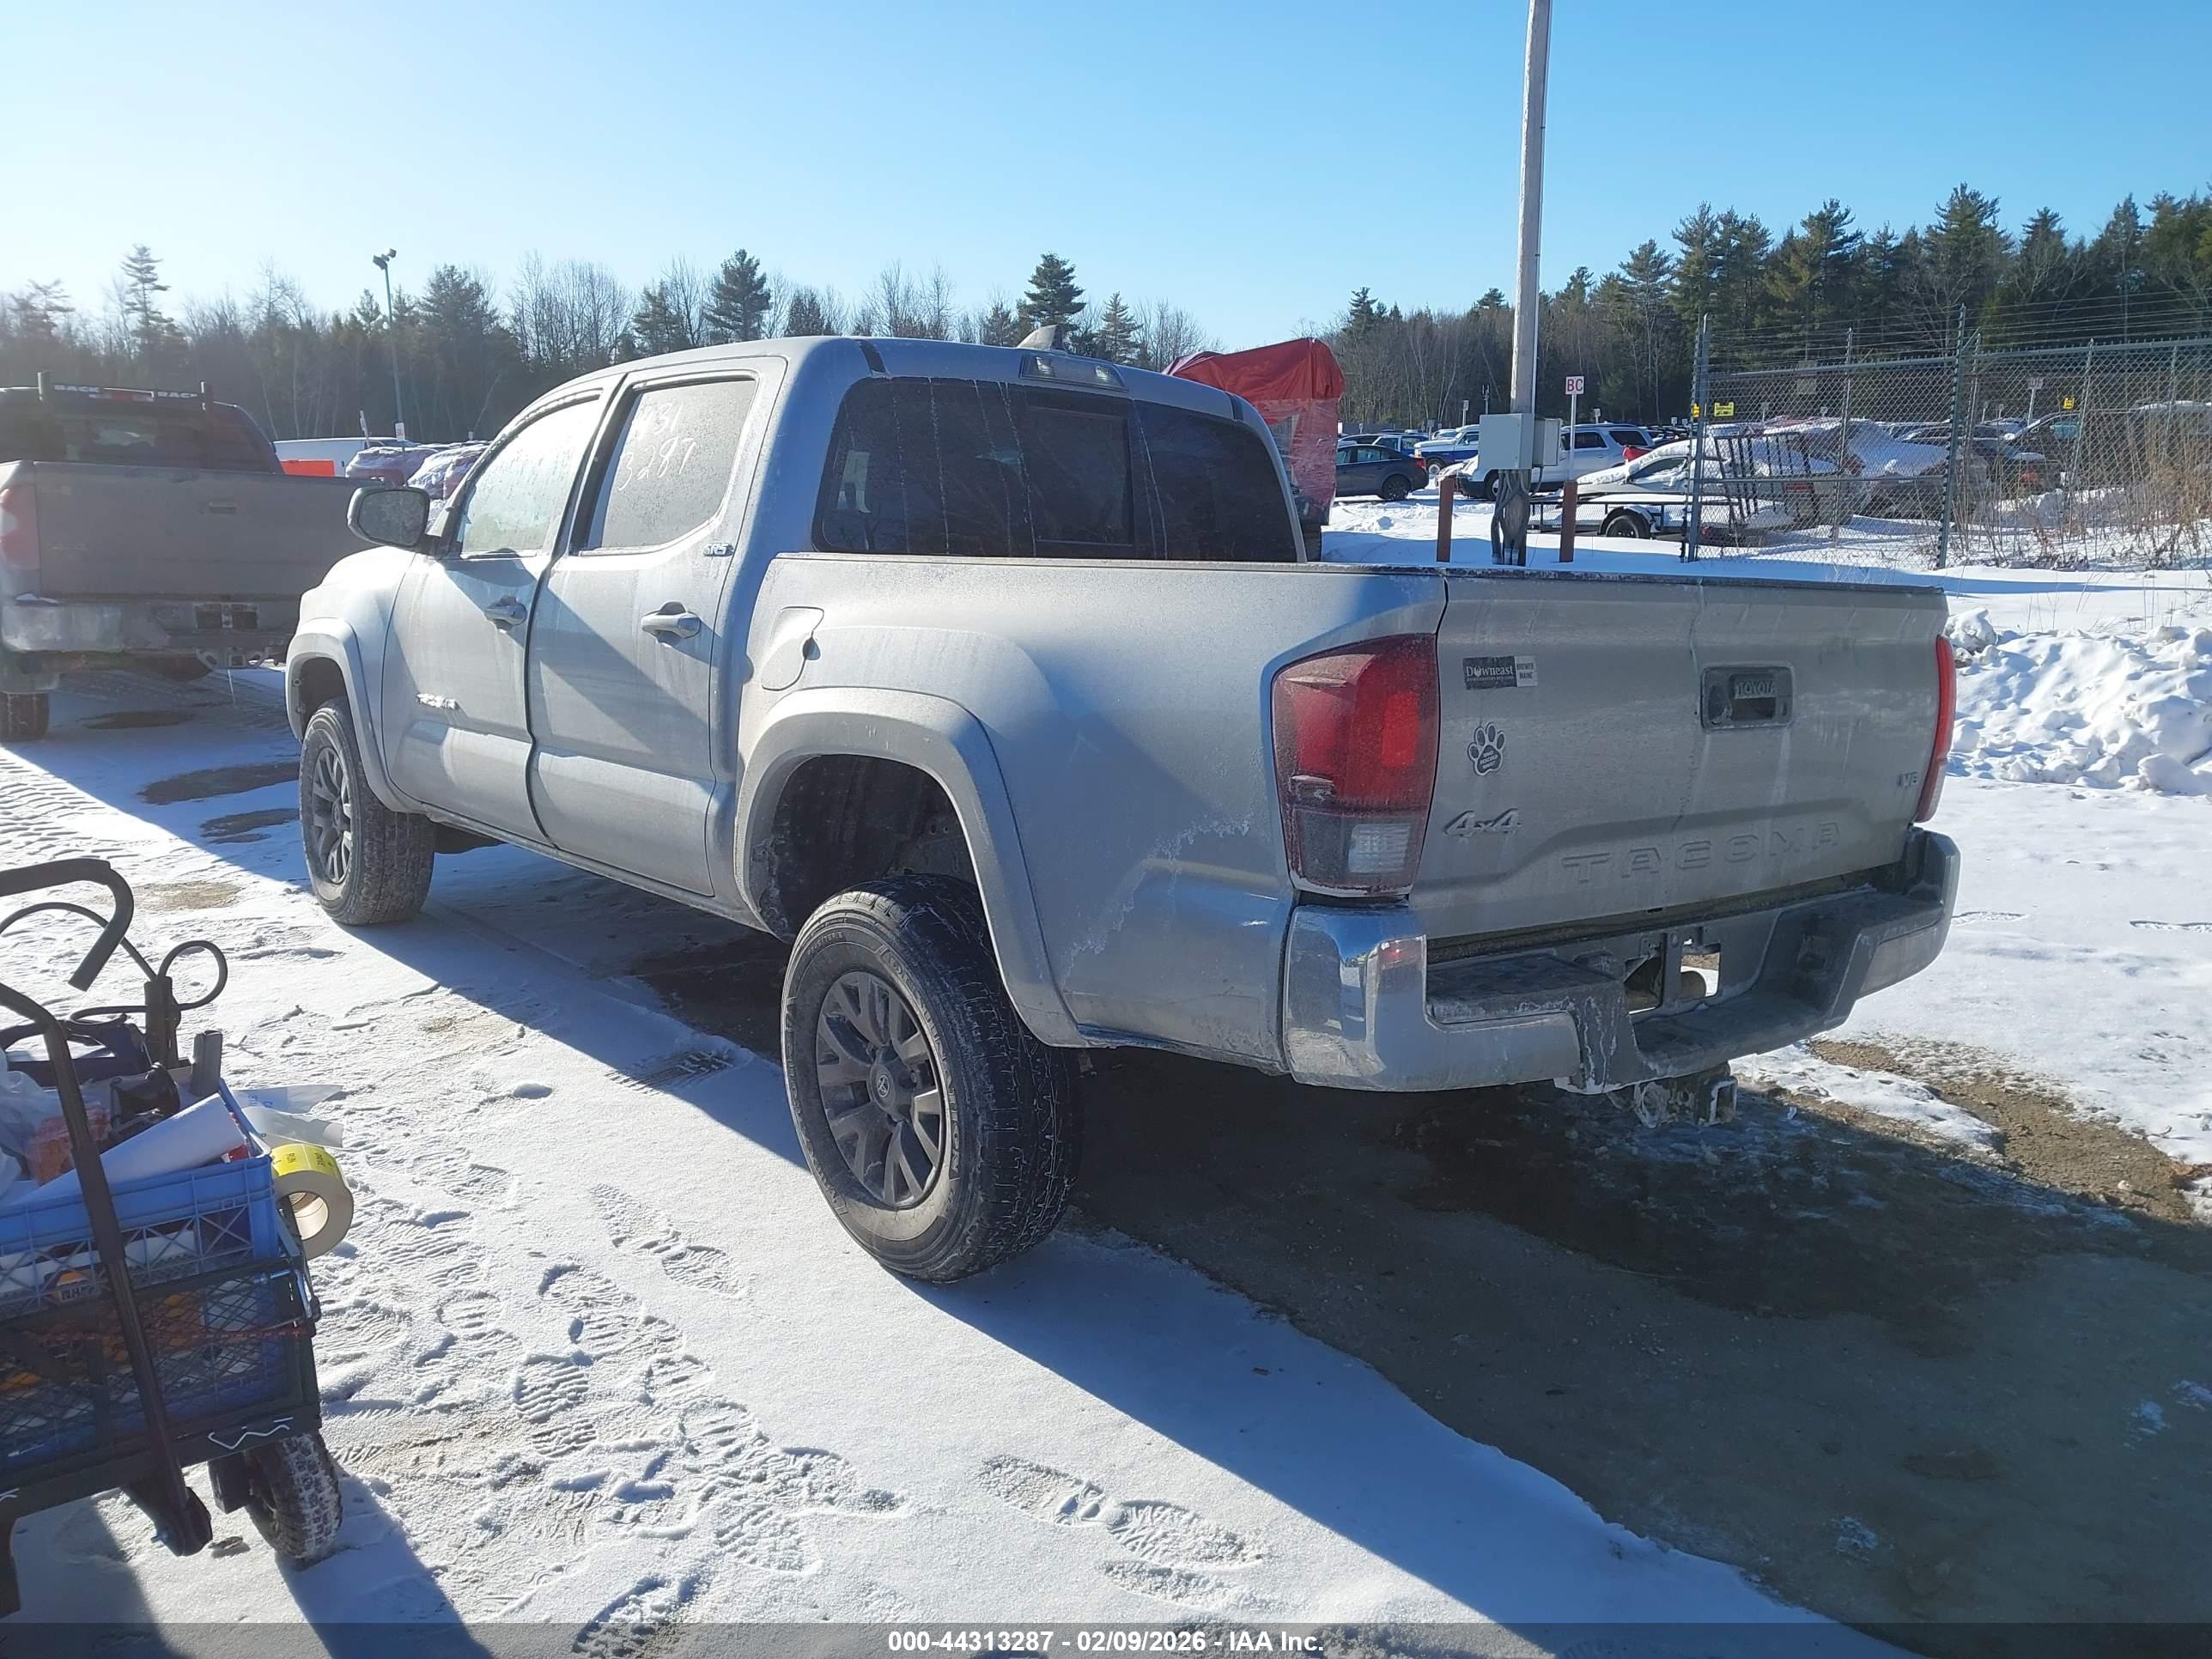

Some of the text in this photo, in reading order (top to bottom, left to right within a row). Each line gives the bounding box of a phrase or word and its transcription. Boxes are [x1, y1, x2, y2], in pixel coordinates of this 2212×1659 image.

[1566, 379, 1583, 392] BC
[618, 436, 697, 491] 3287
[1561, 822, 1840, 884] TACOMA
